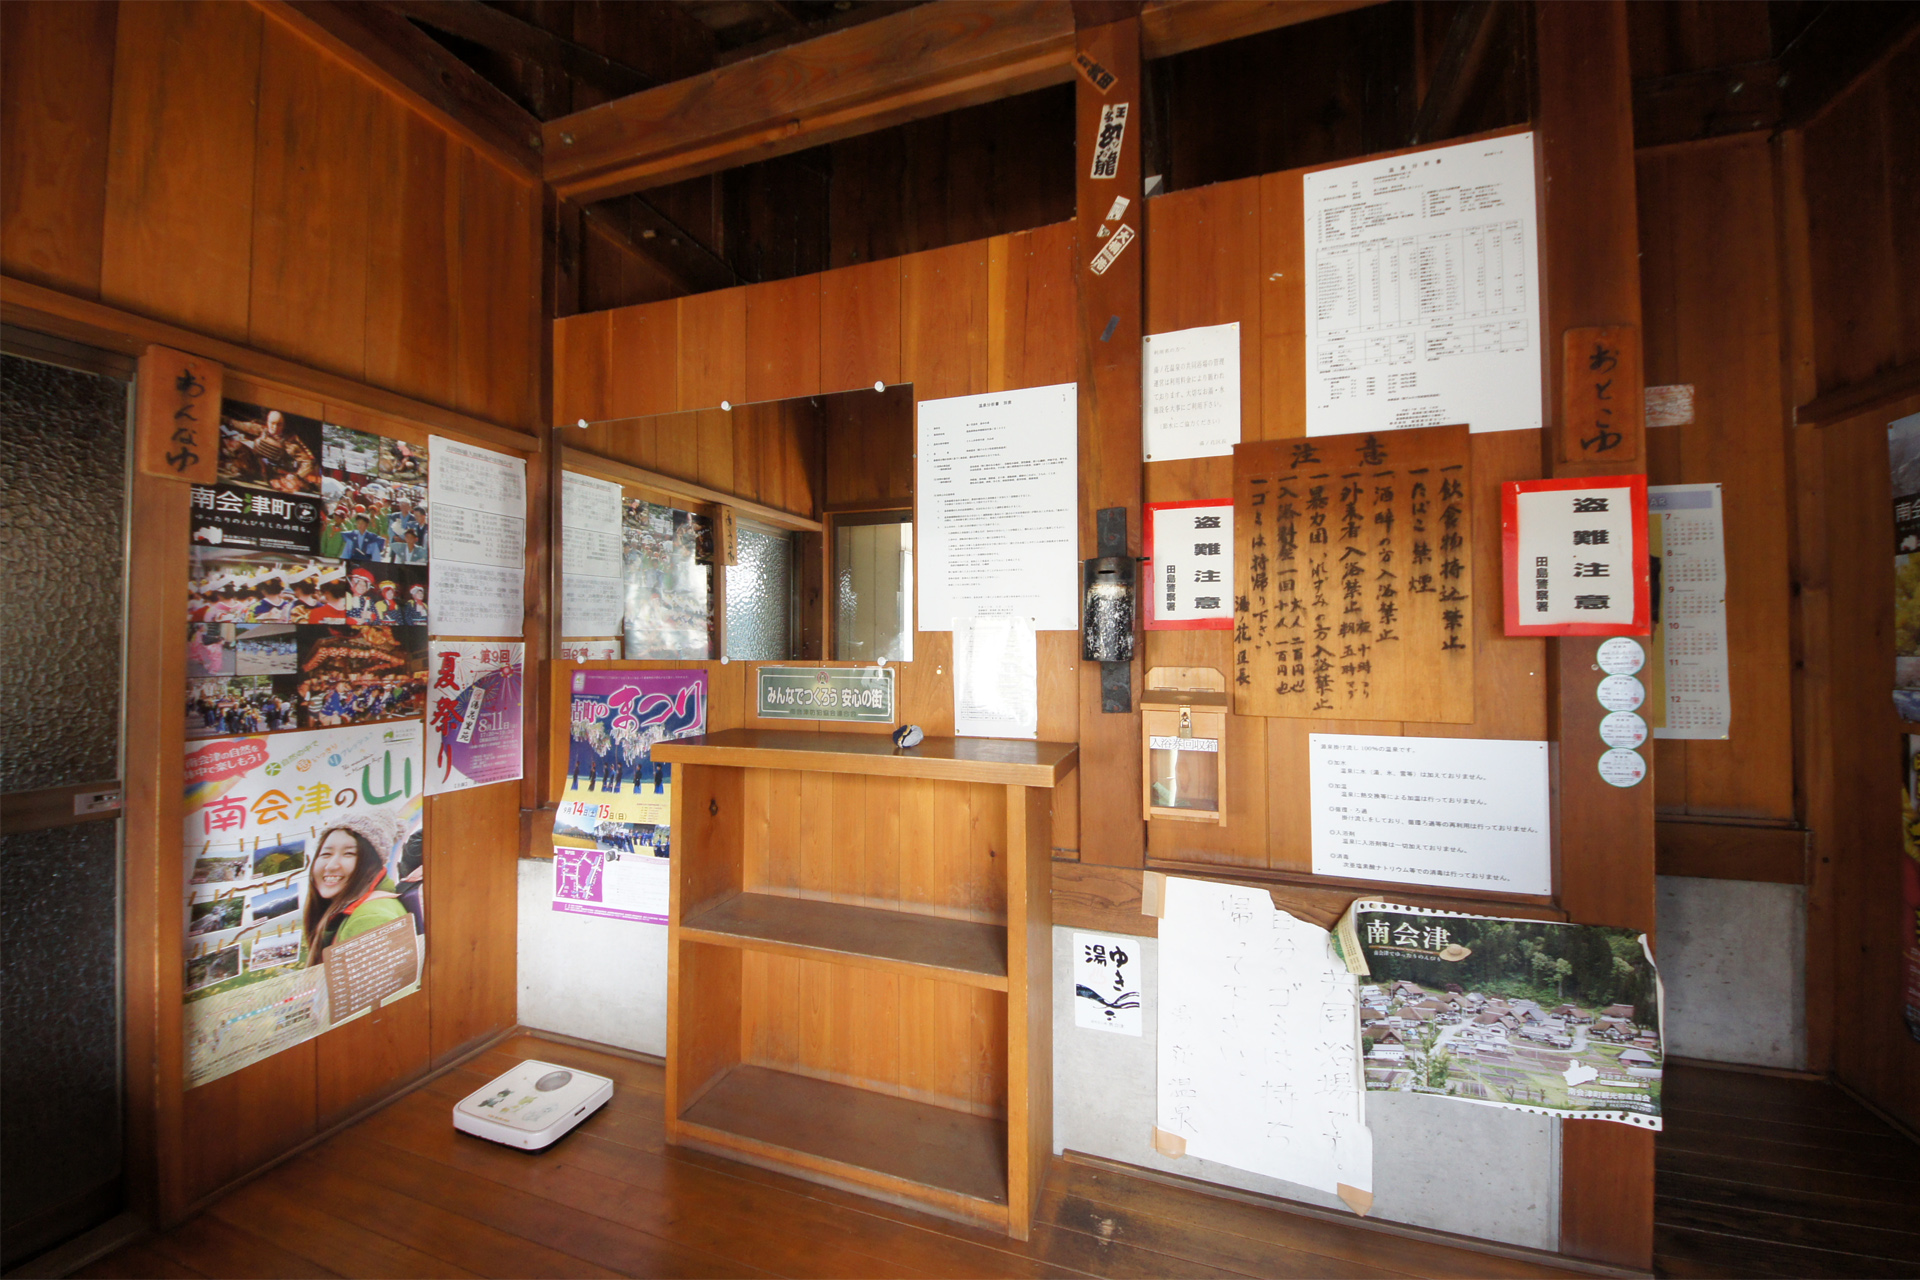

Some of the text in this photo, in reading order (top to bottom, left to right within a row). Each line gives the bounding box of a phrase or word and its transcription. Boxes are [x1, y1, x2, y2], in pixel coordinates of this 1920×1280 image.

[1580, 345, 1623, 453] おとこゆ
[166, 368, 206, 473] おんなゆ
[1290, 434, 1388, 469] 注意
[190, 487, 296, 520] 南会津町
[1193, 515, 1221, 609] 盗難注意
[1573, 497, 1611, 610] 盗難注意
[1166, 565, 1176, 611] 田島警察署
[1535, 556, 1549, 612] 田島警察署
[1669, 622, 1680, 630] 10
[480, 649, 511, 664] 第9回
[430, 651, 464, 784] 夏祭り
[767, 686, 883, 709] みんなでつくろう 安心の街
[1671, 695, 1681, 703] 12
[1150, 736, 1218, 753] 入浴券回収箱
[203, 749, 412, 835] 南会津の山
[1366, 919, 1452, 951] 南会津
